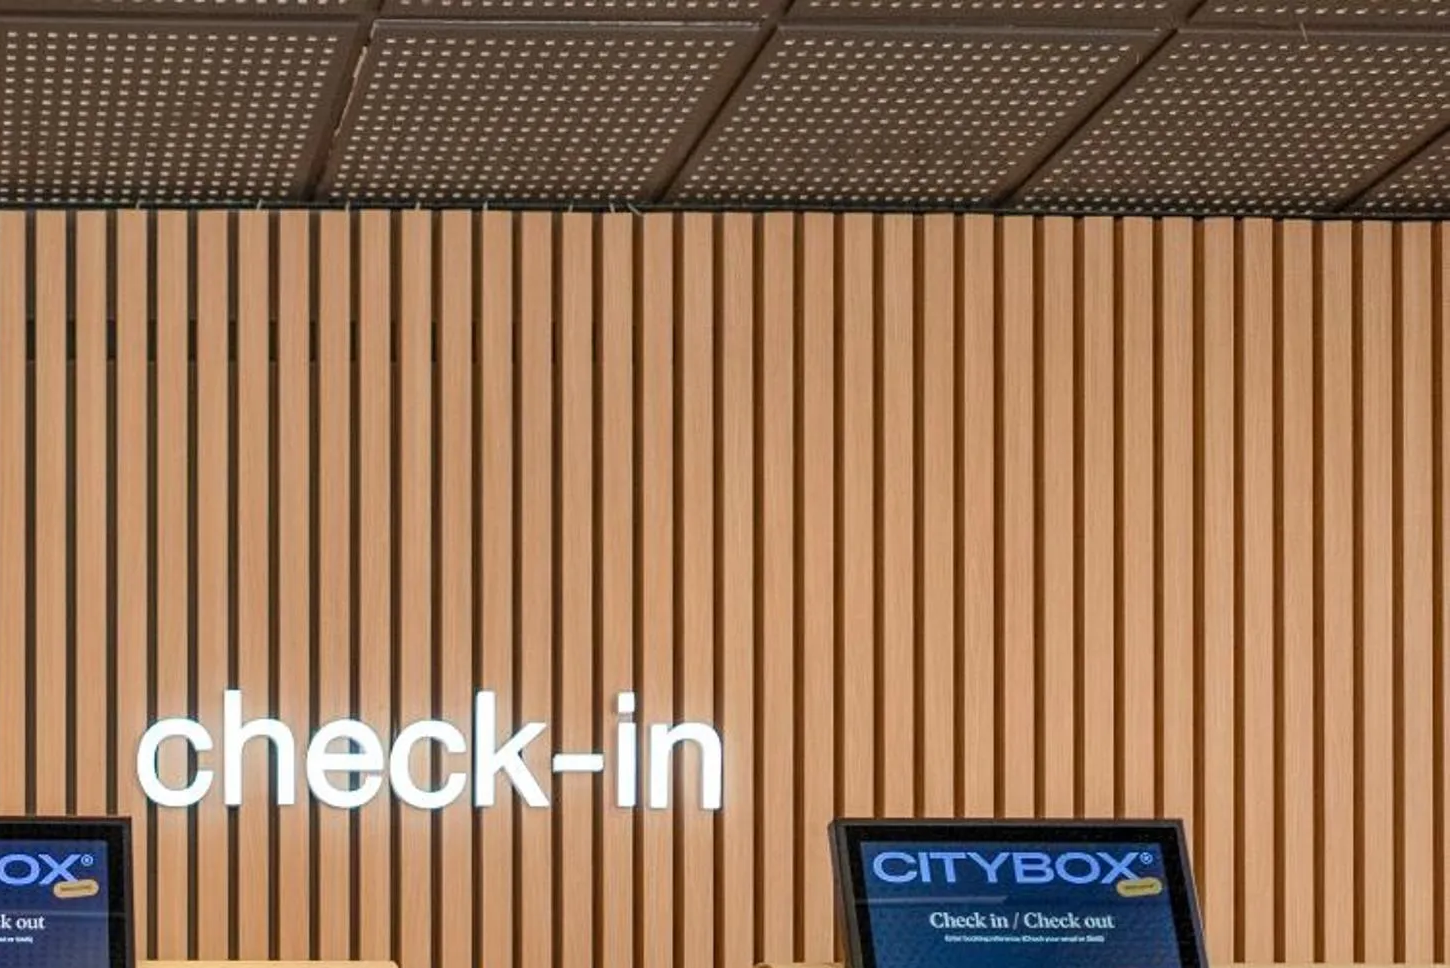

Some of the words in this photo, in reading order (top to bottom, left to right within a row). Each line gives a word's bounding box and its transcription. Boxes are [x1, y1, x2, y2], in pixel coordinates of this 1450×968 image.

[136, 689, 723, 810] check-in
[16, 916, 45, 930] out
[929, 913, 987, 929] Check
[990, 913, 1009, 928] in
[1024, 913, 1082, 929] Check
[1085, 914, 1115, 929] out
